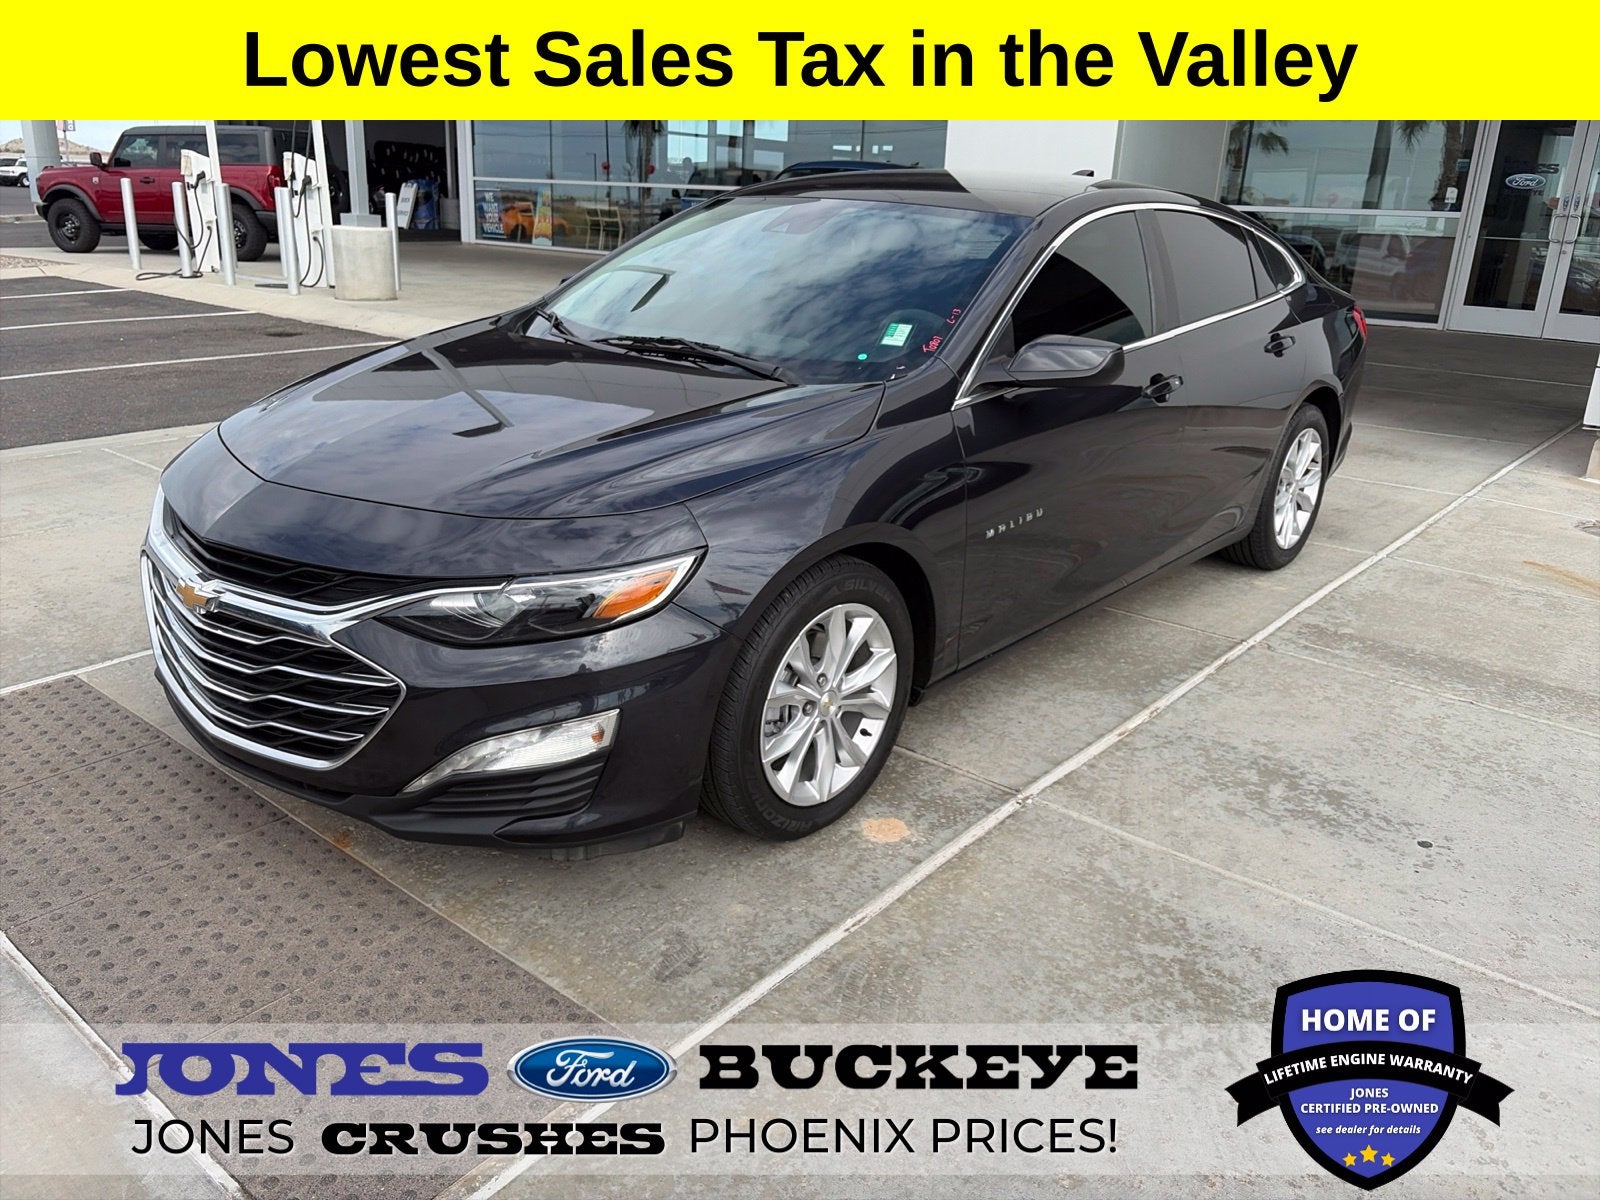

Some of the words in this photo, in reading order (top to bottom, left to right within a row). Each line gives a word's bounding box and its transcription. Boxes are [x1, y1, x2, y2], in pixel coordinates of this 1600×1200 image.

[484, 192, 494, 201] WE
[483, 202, 498, 212] WANT
[485, 213, 499, 223] YOUR
[482, 223, 504, 233] VEHICLE
[986, 508, 1043, 539] MALIBU
